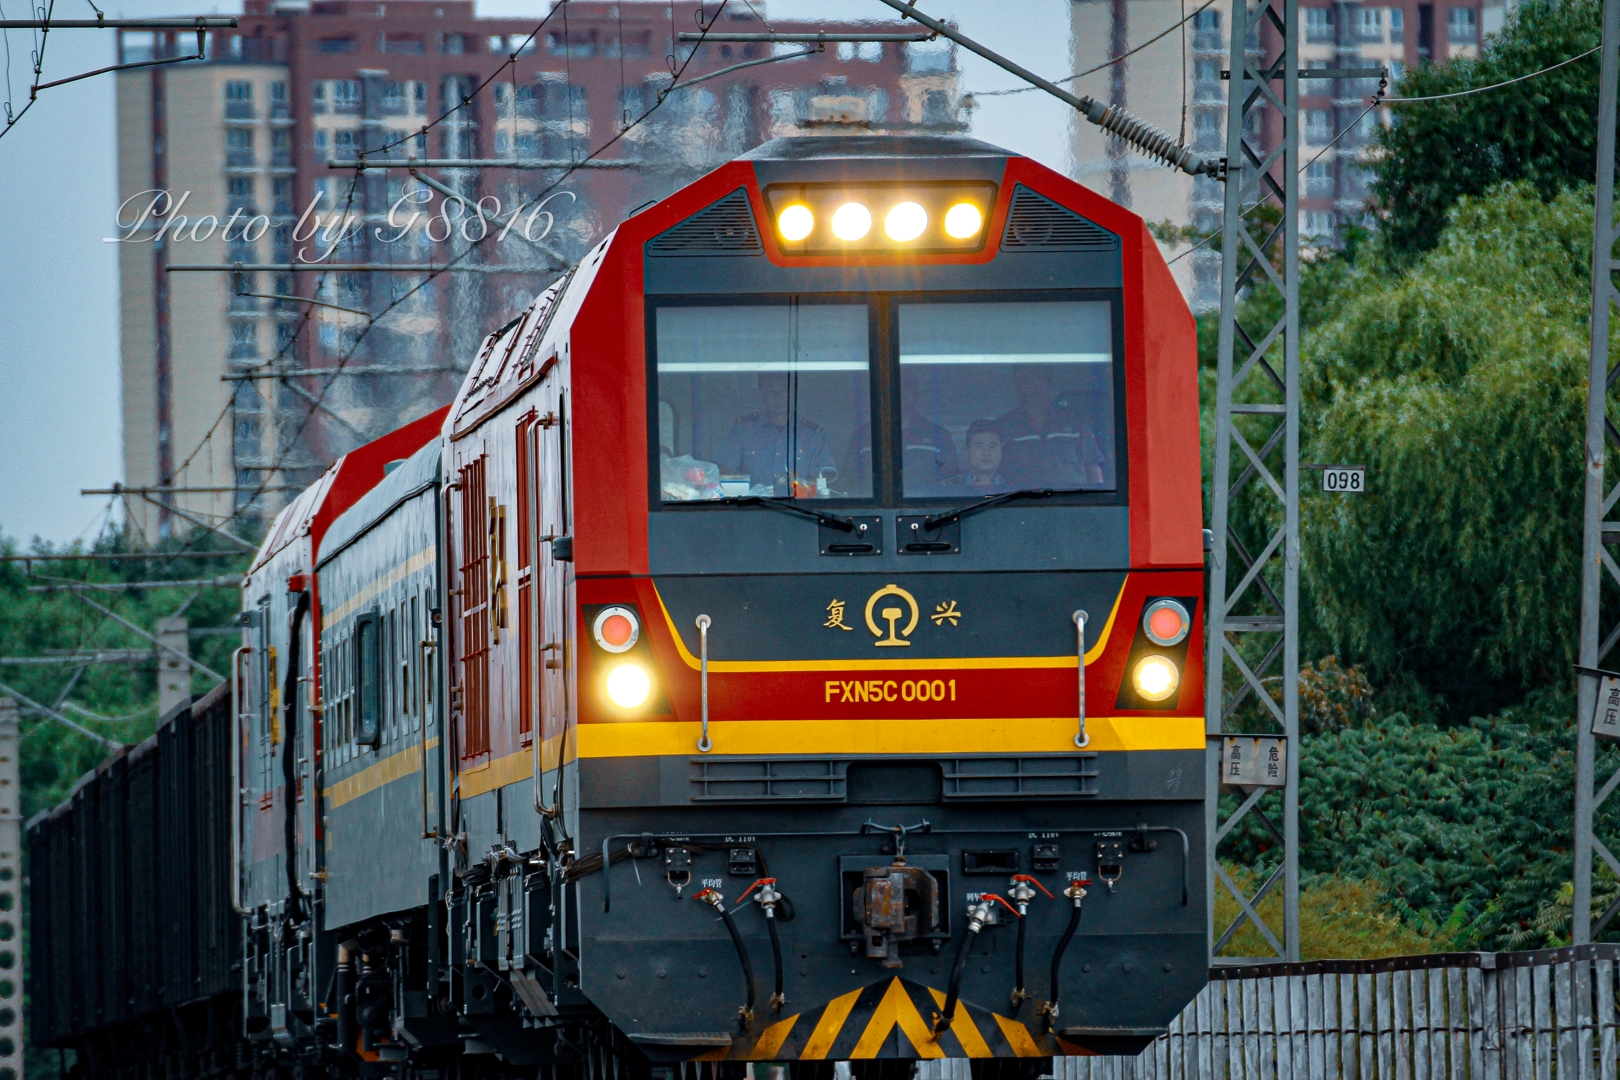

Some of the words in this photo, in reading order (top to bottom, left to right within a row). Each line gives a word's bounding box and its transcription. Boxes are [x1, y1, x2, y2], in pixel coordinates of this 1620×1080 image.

[1327, 472, 1360, 489] 098
[823, 598, 853, 631] 复
[930, 600, 962, 626] 兴
[825, 680, 898, 703] FXN5C
[901, 679, 956, 702] 0001
[1604, 688, 1620, 725] 高压
[1230, 745, 1241, 776] 高压
[1267, 746, 1279, 778] 危险
[701, 878, 722, 888] 平均管
[1066, 871, 1087, 881] 平均管
